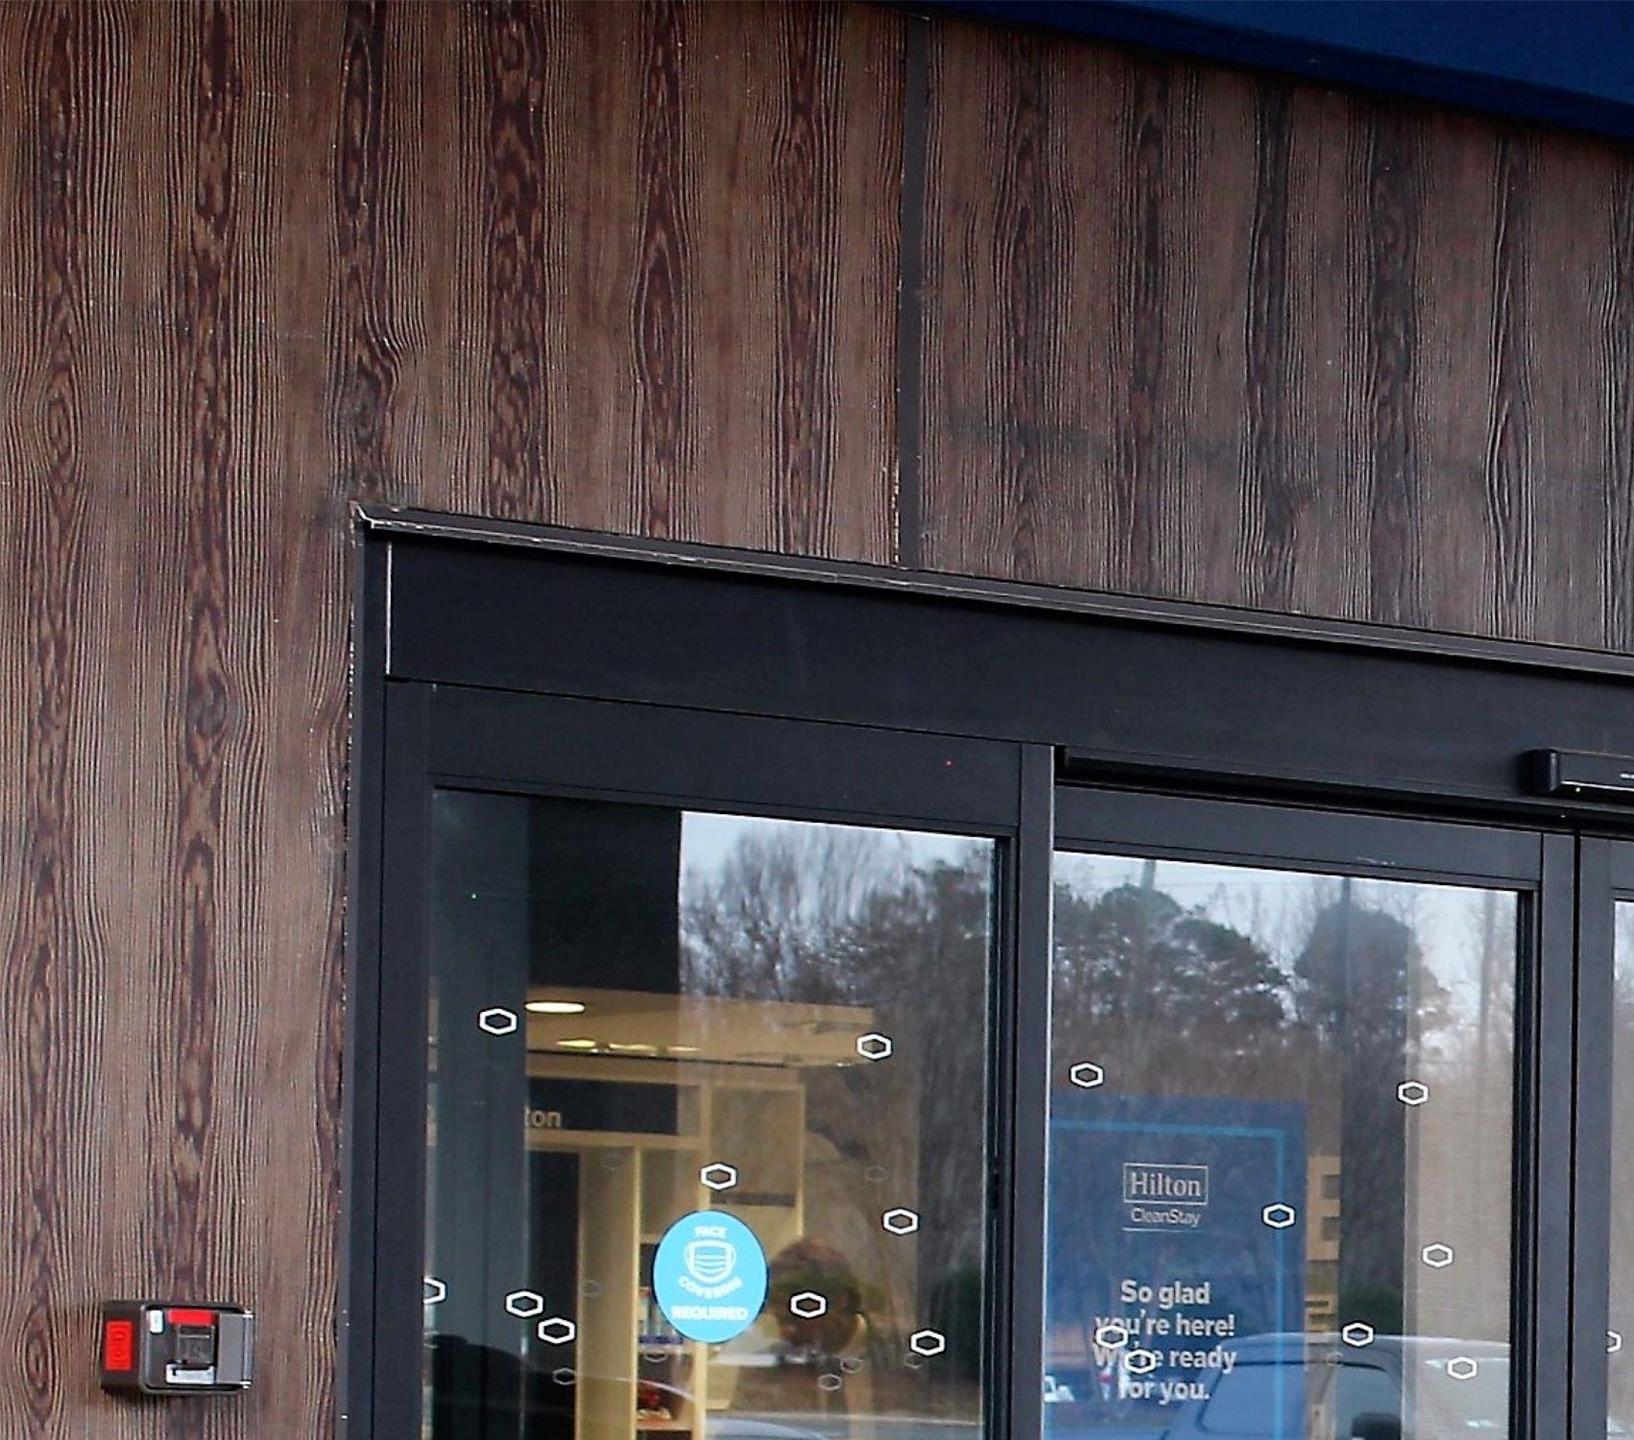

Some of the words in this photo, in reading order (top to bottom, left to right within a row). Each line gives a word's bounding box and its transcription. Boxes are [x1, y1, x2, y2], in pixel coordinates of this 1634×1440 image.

[1131, 1171, 1201, 1197] Hilton
[1131, 1207, 1202, 1228] CleanStay
[694, 1226, 727, 1237] FACE
[679, 1276, 743, 1299] COVERING
[1120, 1279, 1153, 1303] So
[1158, 1281, 1211, 1310] glad
[672, 1305, 749, 1320] REQUIRED
[1175, 1312, 1236, 1337] here!
[1169, 1344, 1238, 1375] ready
[1158, 1380, 1211, 1406] you.
